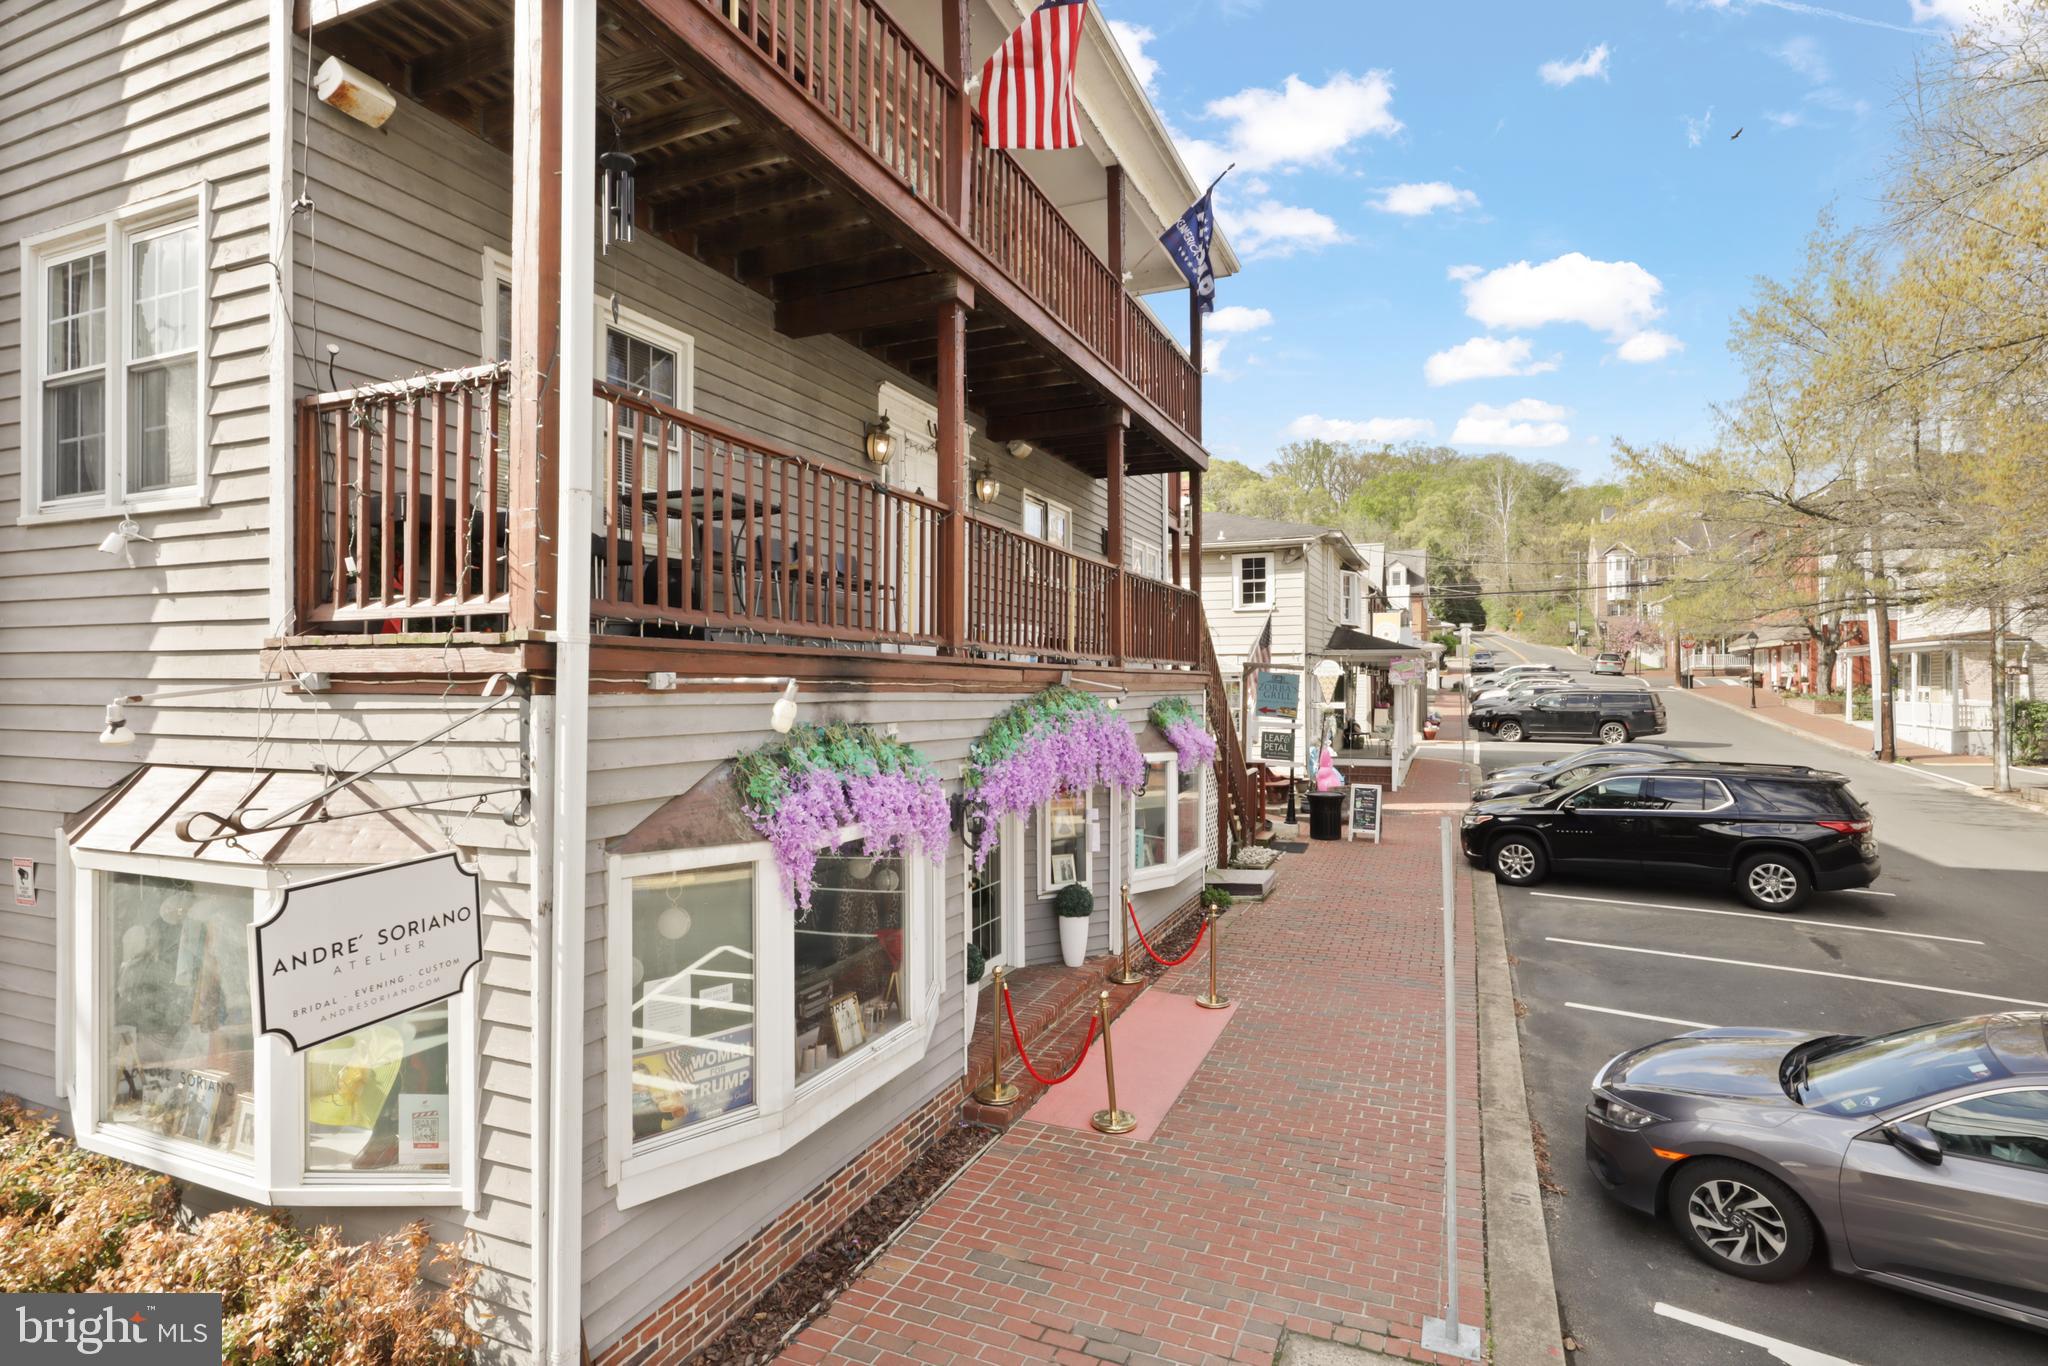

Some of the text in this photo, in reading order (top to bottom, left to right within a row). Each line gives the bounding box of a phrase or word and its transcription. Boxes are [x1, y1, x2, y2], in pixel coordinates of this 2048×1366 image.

[1263, 691, 1292, 700] GRILL
[1264, 733, 1284, 743] LEAF
[1264, 742, 1289, 752] PETAL
[378, 906, 471, 945] SORIANO
[333, 940, 426, 975] ATELIER
[292, 957, 460, 1018] BRIDAL EVENING CUSTOM
[320, 976, 441, 1022] ANDRESORIANO.COM
[180, 1071, 236, 1097] SORIANO
[690, 1070, 750, 1100] TRUMP
[710, 1065, 726, 1077] FOR
